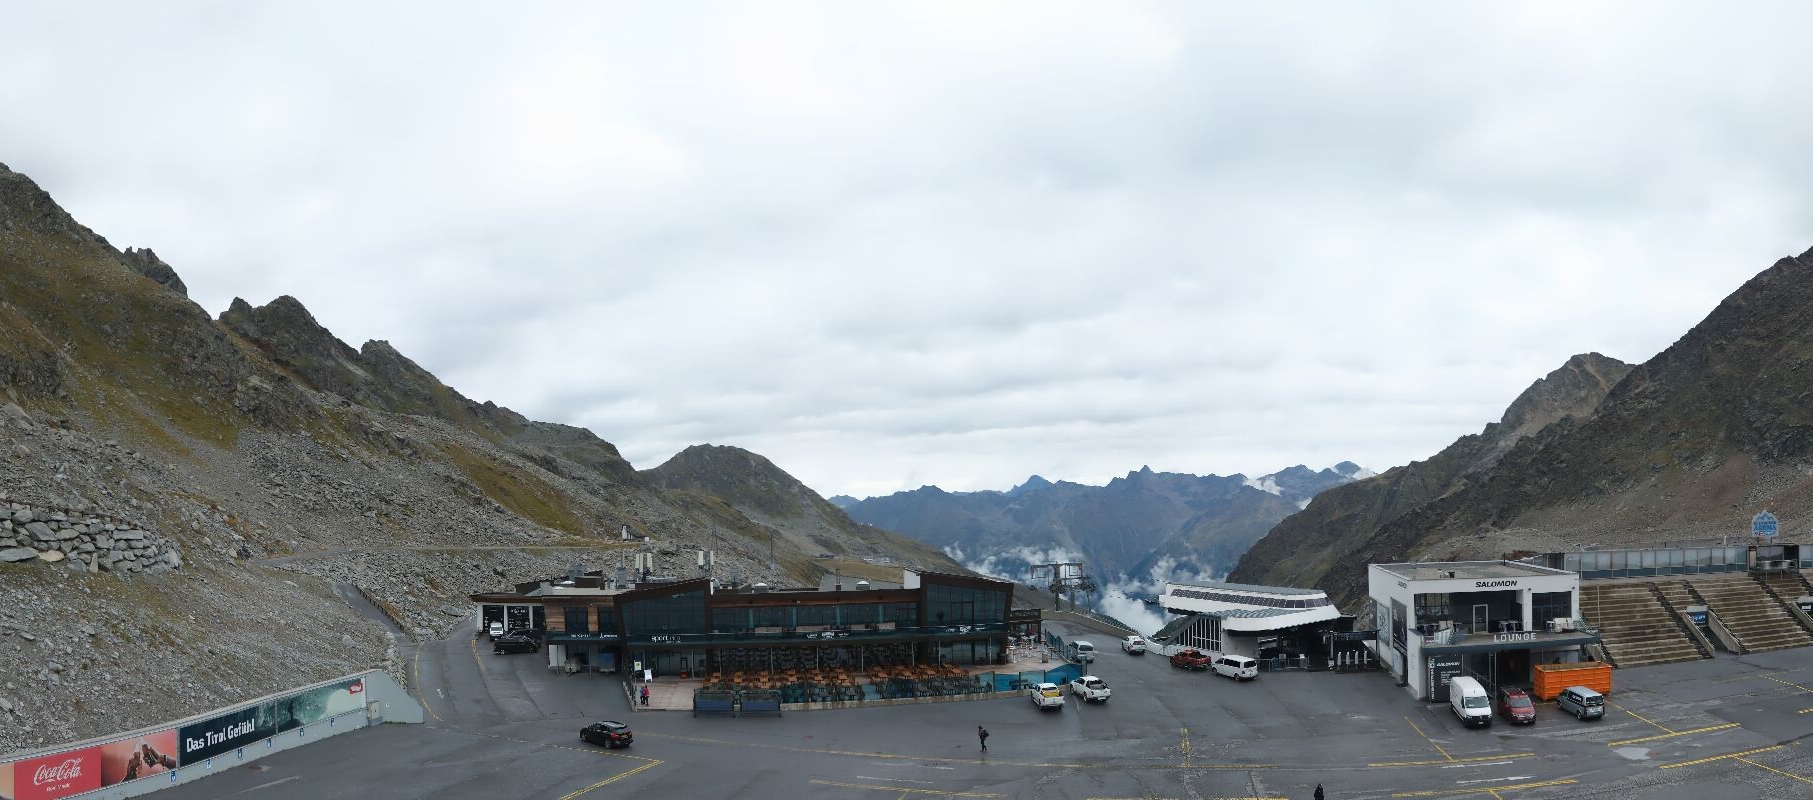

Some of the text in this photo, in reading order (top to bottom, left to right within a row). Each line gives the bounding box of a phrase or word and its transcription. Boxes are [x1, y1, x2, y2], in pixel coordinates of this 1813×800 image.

[1475, 580, 1518, 588] SALOMON
[1493, 632, 1537, 643] LOUNGE
[186, 718, 255, 753] Das Tirol Gefühl
